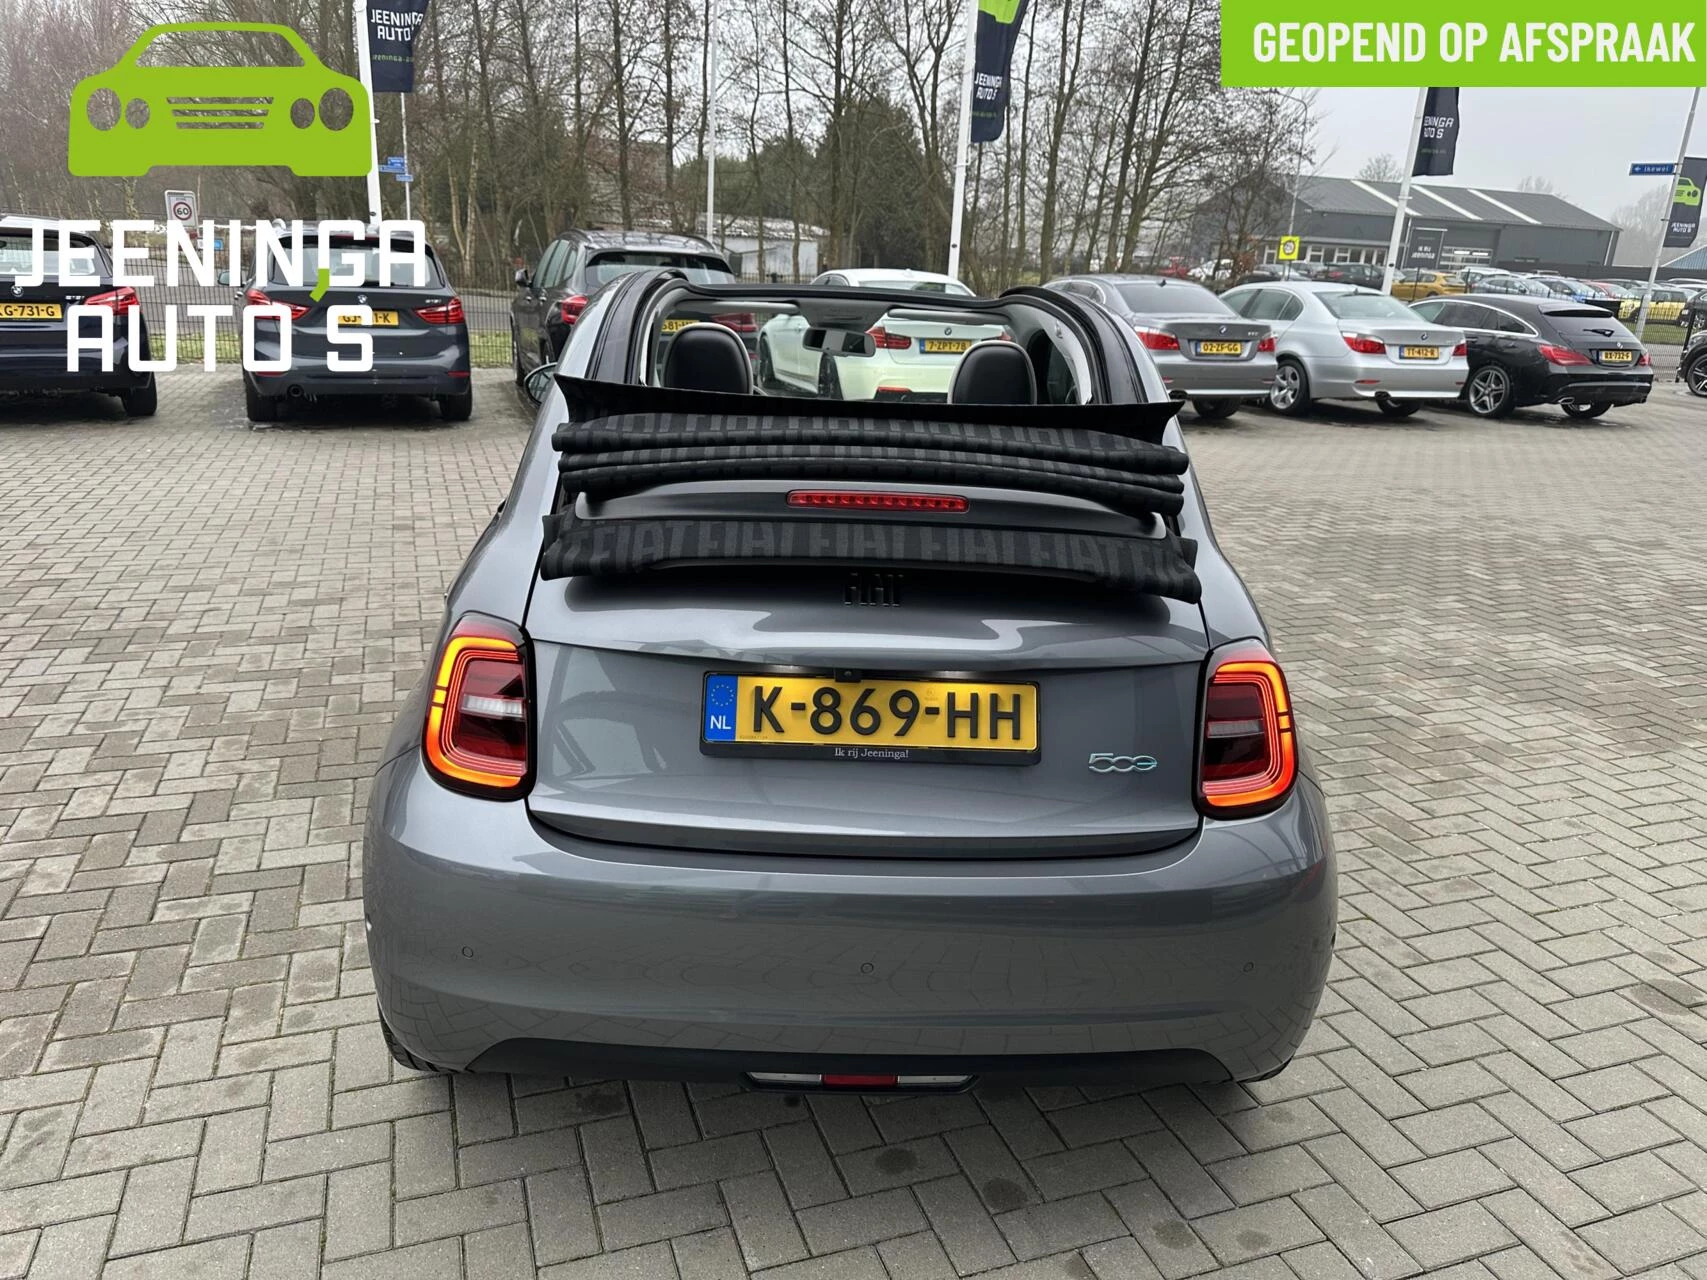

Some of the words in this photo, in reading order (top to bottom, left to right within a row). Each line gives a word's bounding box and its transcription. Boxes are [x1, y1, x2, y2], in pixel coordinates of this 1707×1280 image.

[710, 716, 731, 730] NL
[753, 685, 1021, 740] K-869-HH
[835, 748, 846, 756] Ik
[848, 748, 858, 759] rij
[861, 748, 909, 760] Jeeninga!
